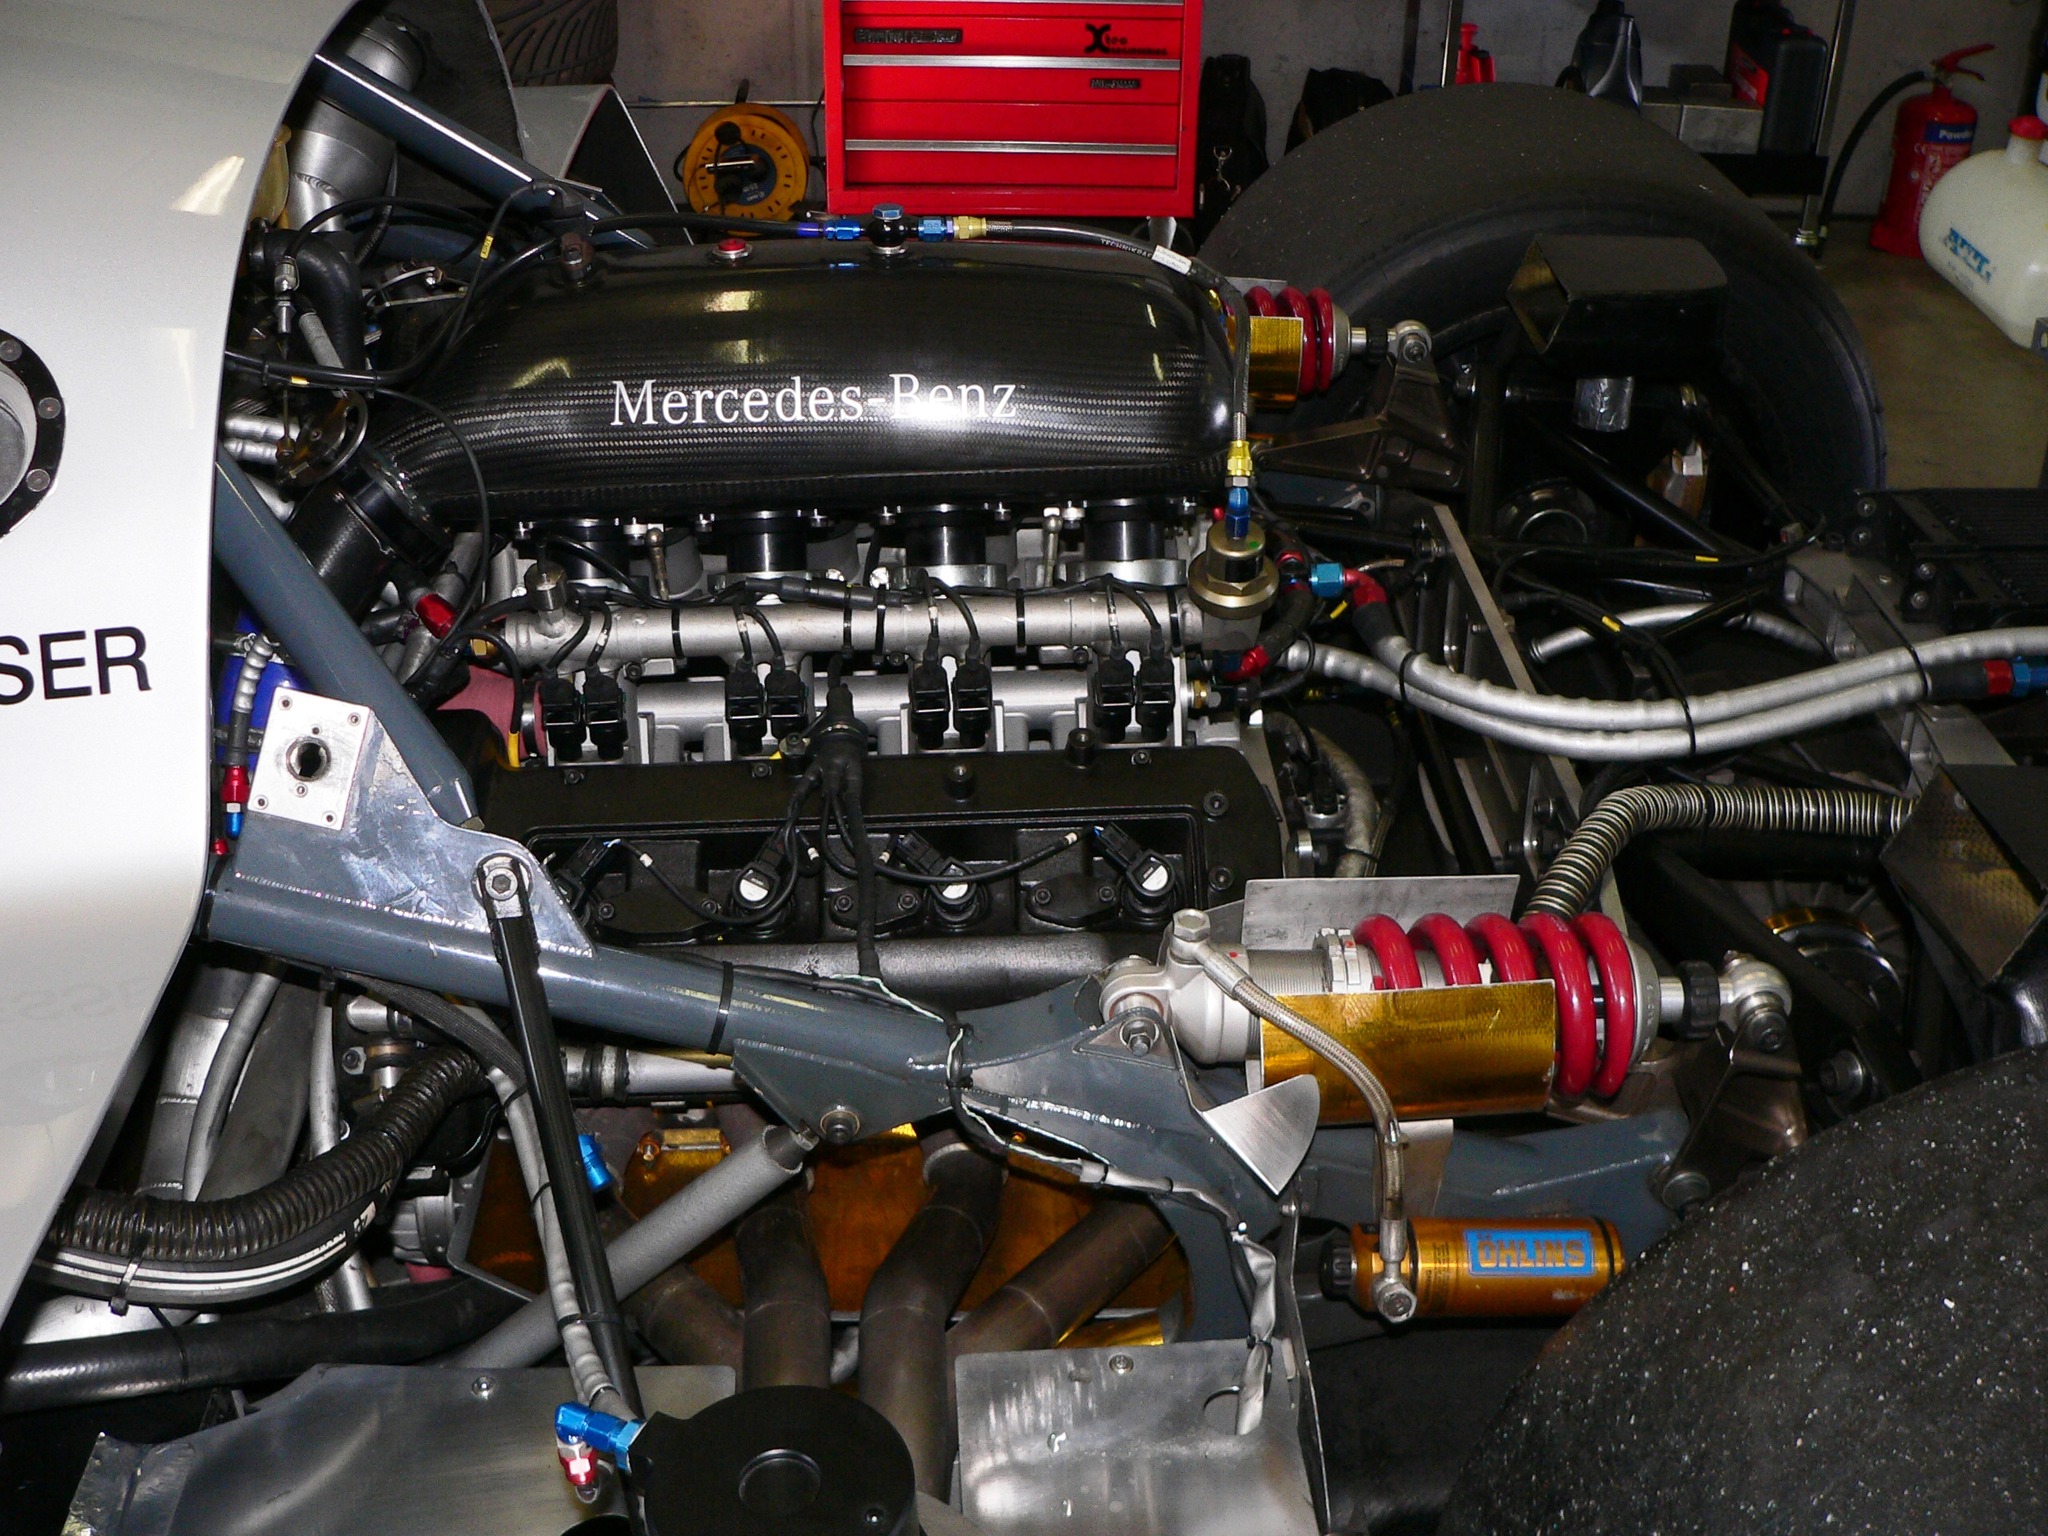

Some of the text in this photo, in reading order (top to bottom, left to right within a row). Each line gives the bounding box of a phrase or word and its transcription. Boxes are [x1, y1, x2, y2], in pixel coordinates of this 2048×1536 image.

[610, 372, 1018, 426] Mercedes-Benz
[0, 626, 152, 705] SER
[1475, 1232, 1586, 1269] ÖHLINS
